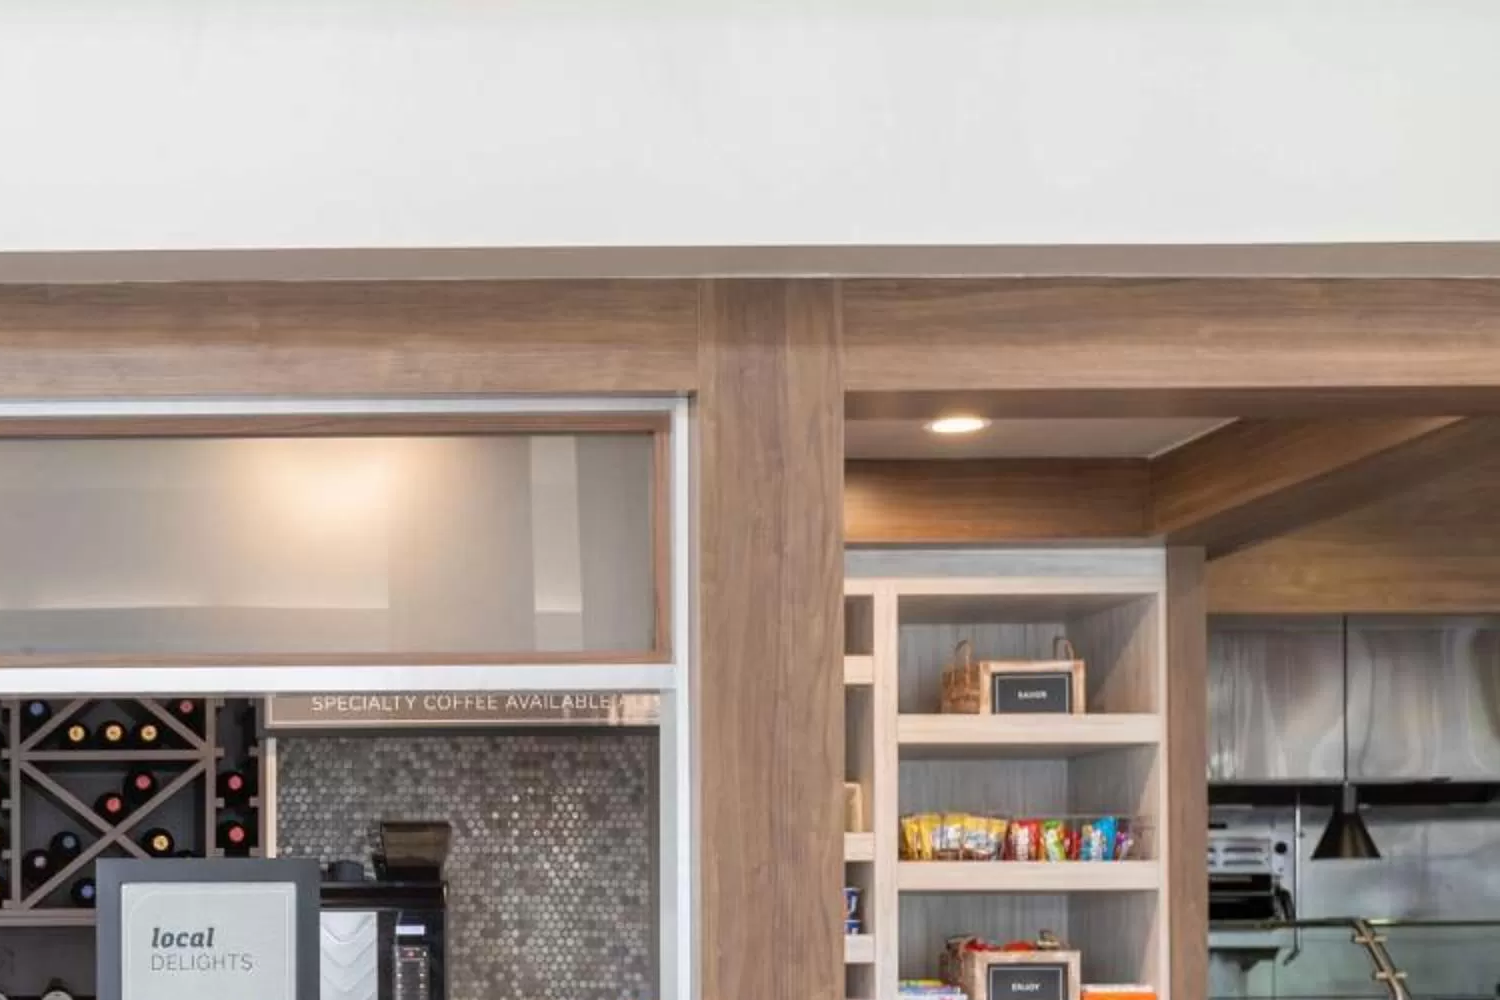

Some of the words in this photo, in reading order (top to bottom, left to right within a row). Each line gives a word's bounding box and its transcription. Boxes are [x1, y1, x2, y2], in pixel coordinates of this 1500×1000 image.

[311, 694, 417, 712] SPECIALTY
[423, 694, 498, 711] COFFEE
[505, 693, 612, 710] AVAILABLE
[151, 926, 215, 949] local
[151, 952, 253, 972] DELIGHTS
[1011, 982, 1040, 993] ENJOY
